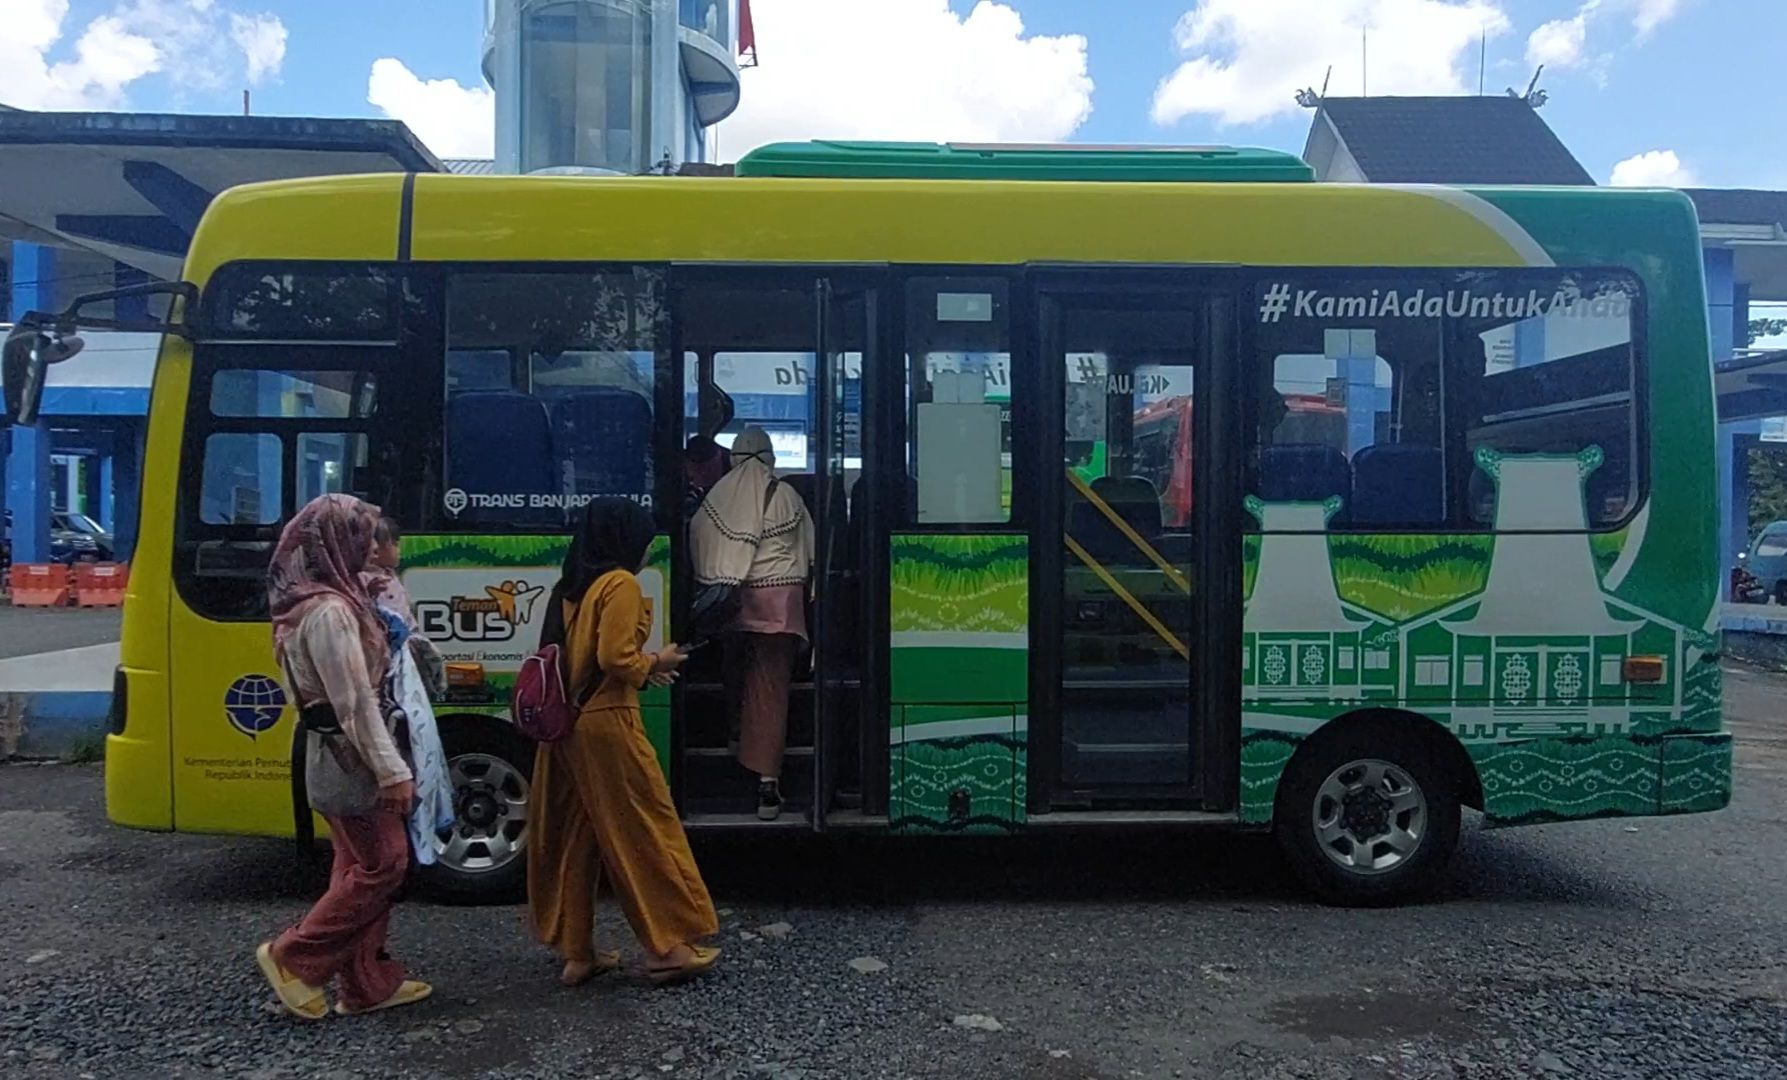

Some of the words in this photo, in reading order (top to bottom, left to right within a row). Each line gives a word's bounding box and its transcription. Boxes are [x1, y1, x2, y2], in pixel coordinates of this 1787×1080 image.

[469, 493, 525, 507] TRANS
[452, 598, 499, 612] Teman
[416, 601, 514, 641] Bus
[442, 652, 474, 663] portasi
[476, 652, 523, 662] Ekonomis
[184, 757, 253, 767] Kementerian
[256, 757, 292, 768] Perhub
[205, 769, 251, 781] Republik
[256, 769, 292, 780] Indone
